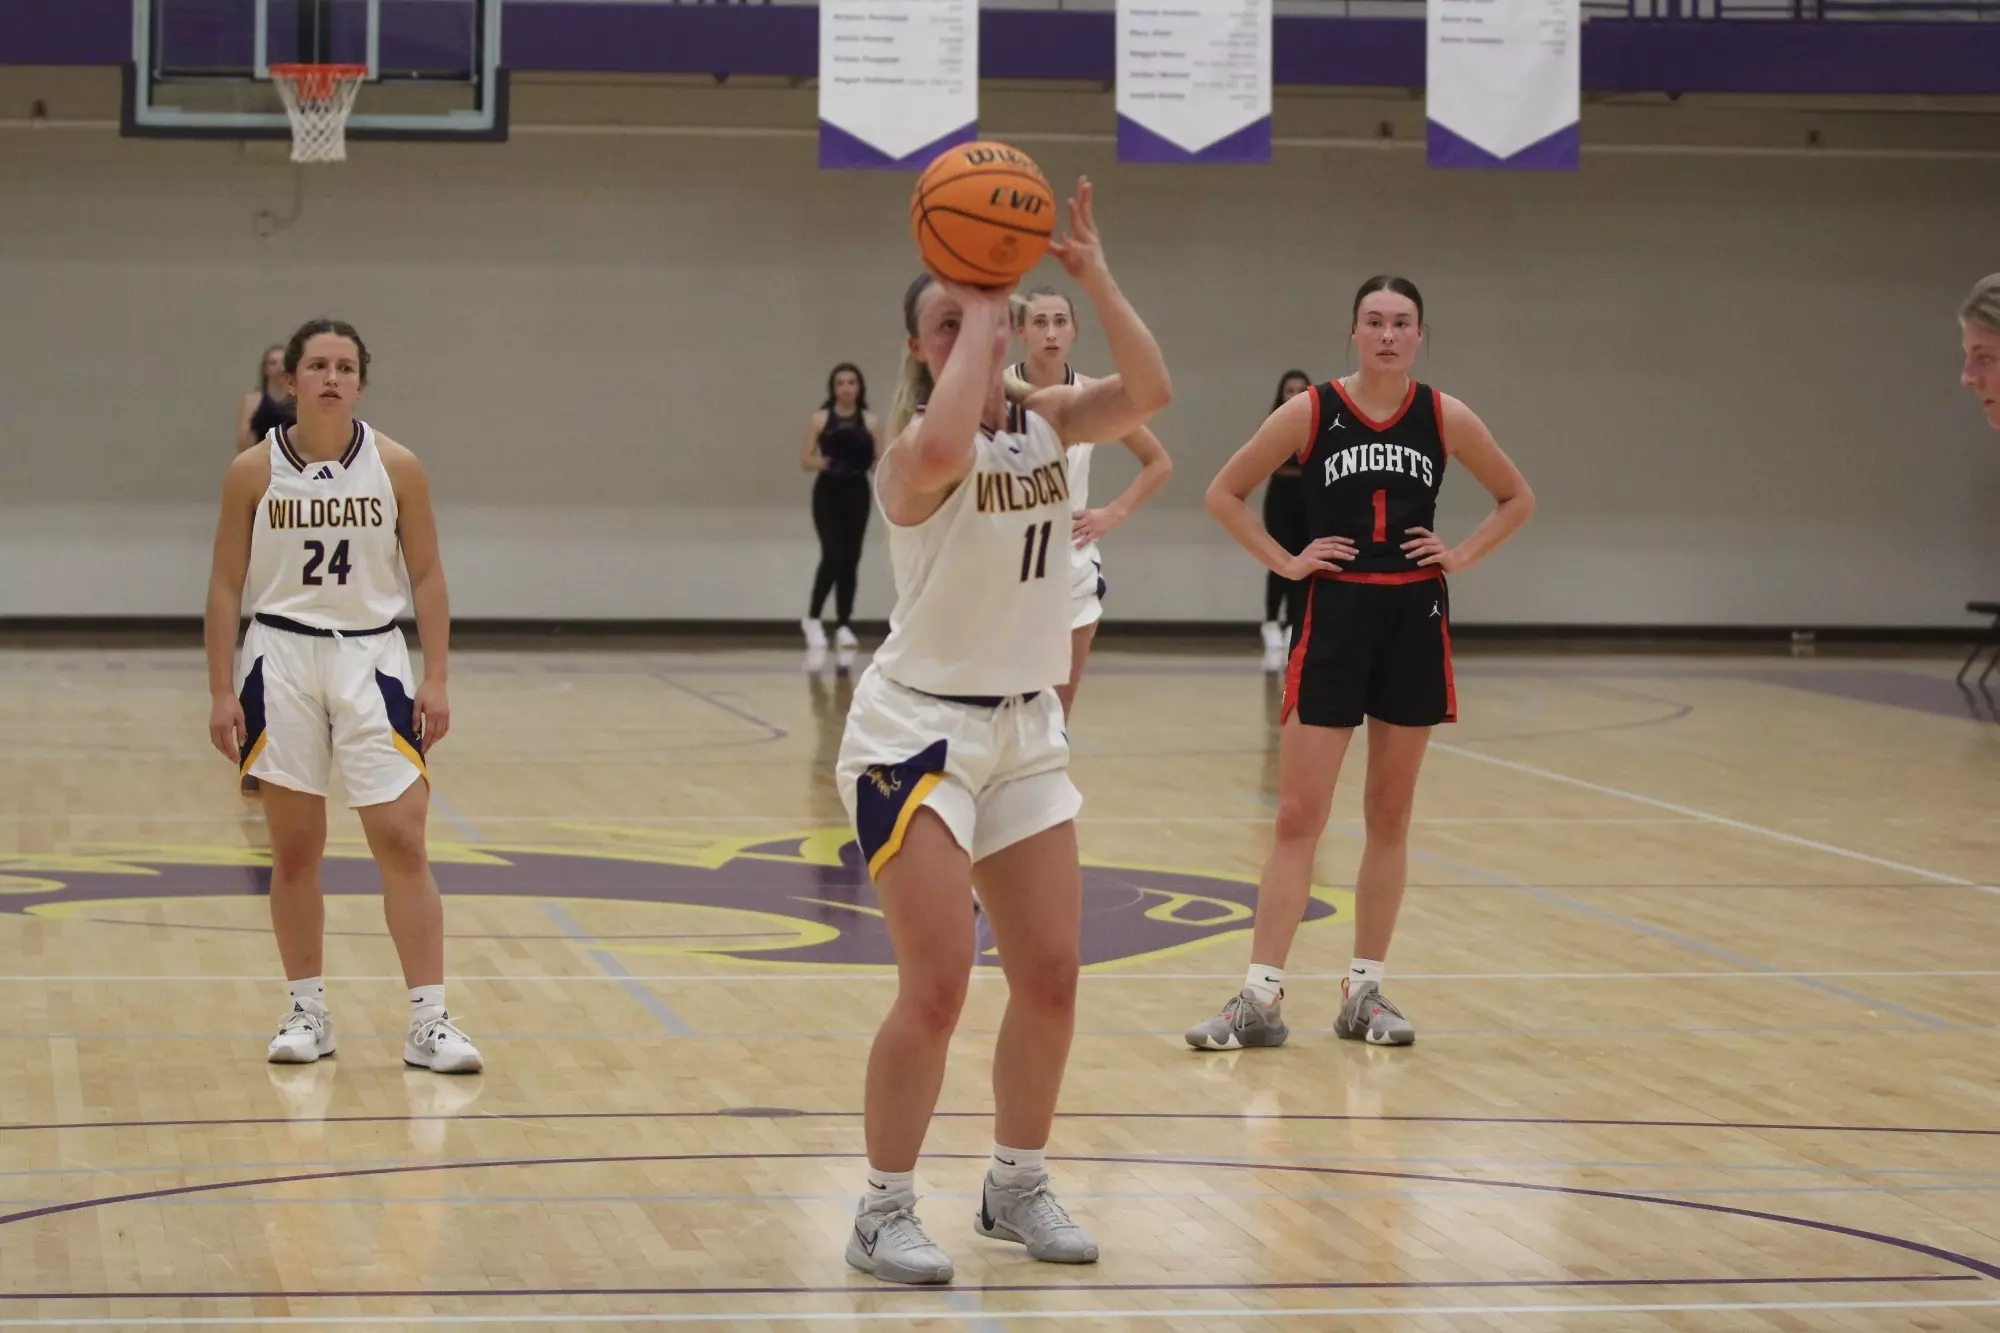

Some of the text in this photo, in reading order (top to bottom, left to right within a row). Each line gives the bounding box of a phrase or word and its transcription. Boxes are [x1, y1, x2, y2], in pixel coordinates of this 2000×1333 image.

[976, 460, 1069, 513] WILDCAT
[1324, 443, 1433, 487] KNIGHTS
[267, 497, 383, 530] WILDCATS
[1372, 489, 1387, 543] 1
[302, 539, 352, 586] 24
[1020, 520, 1052, 583] 11
